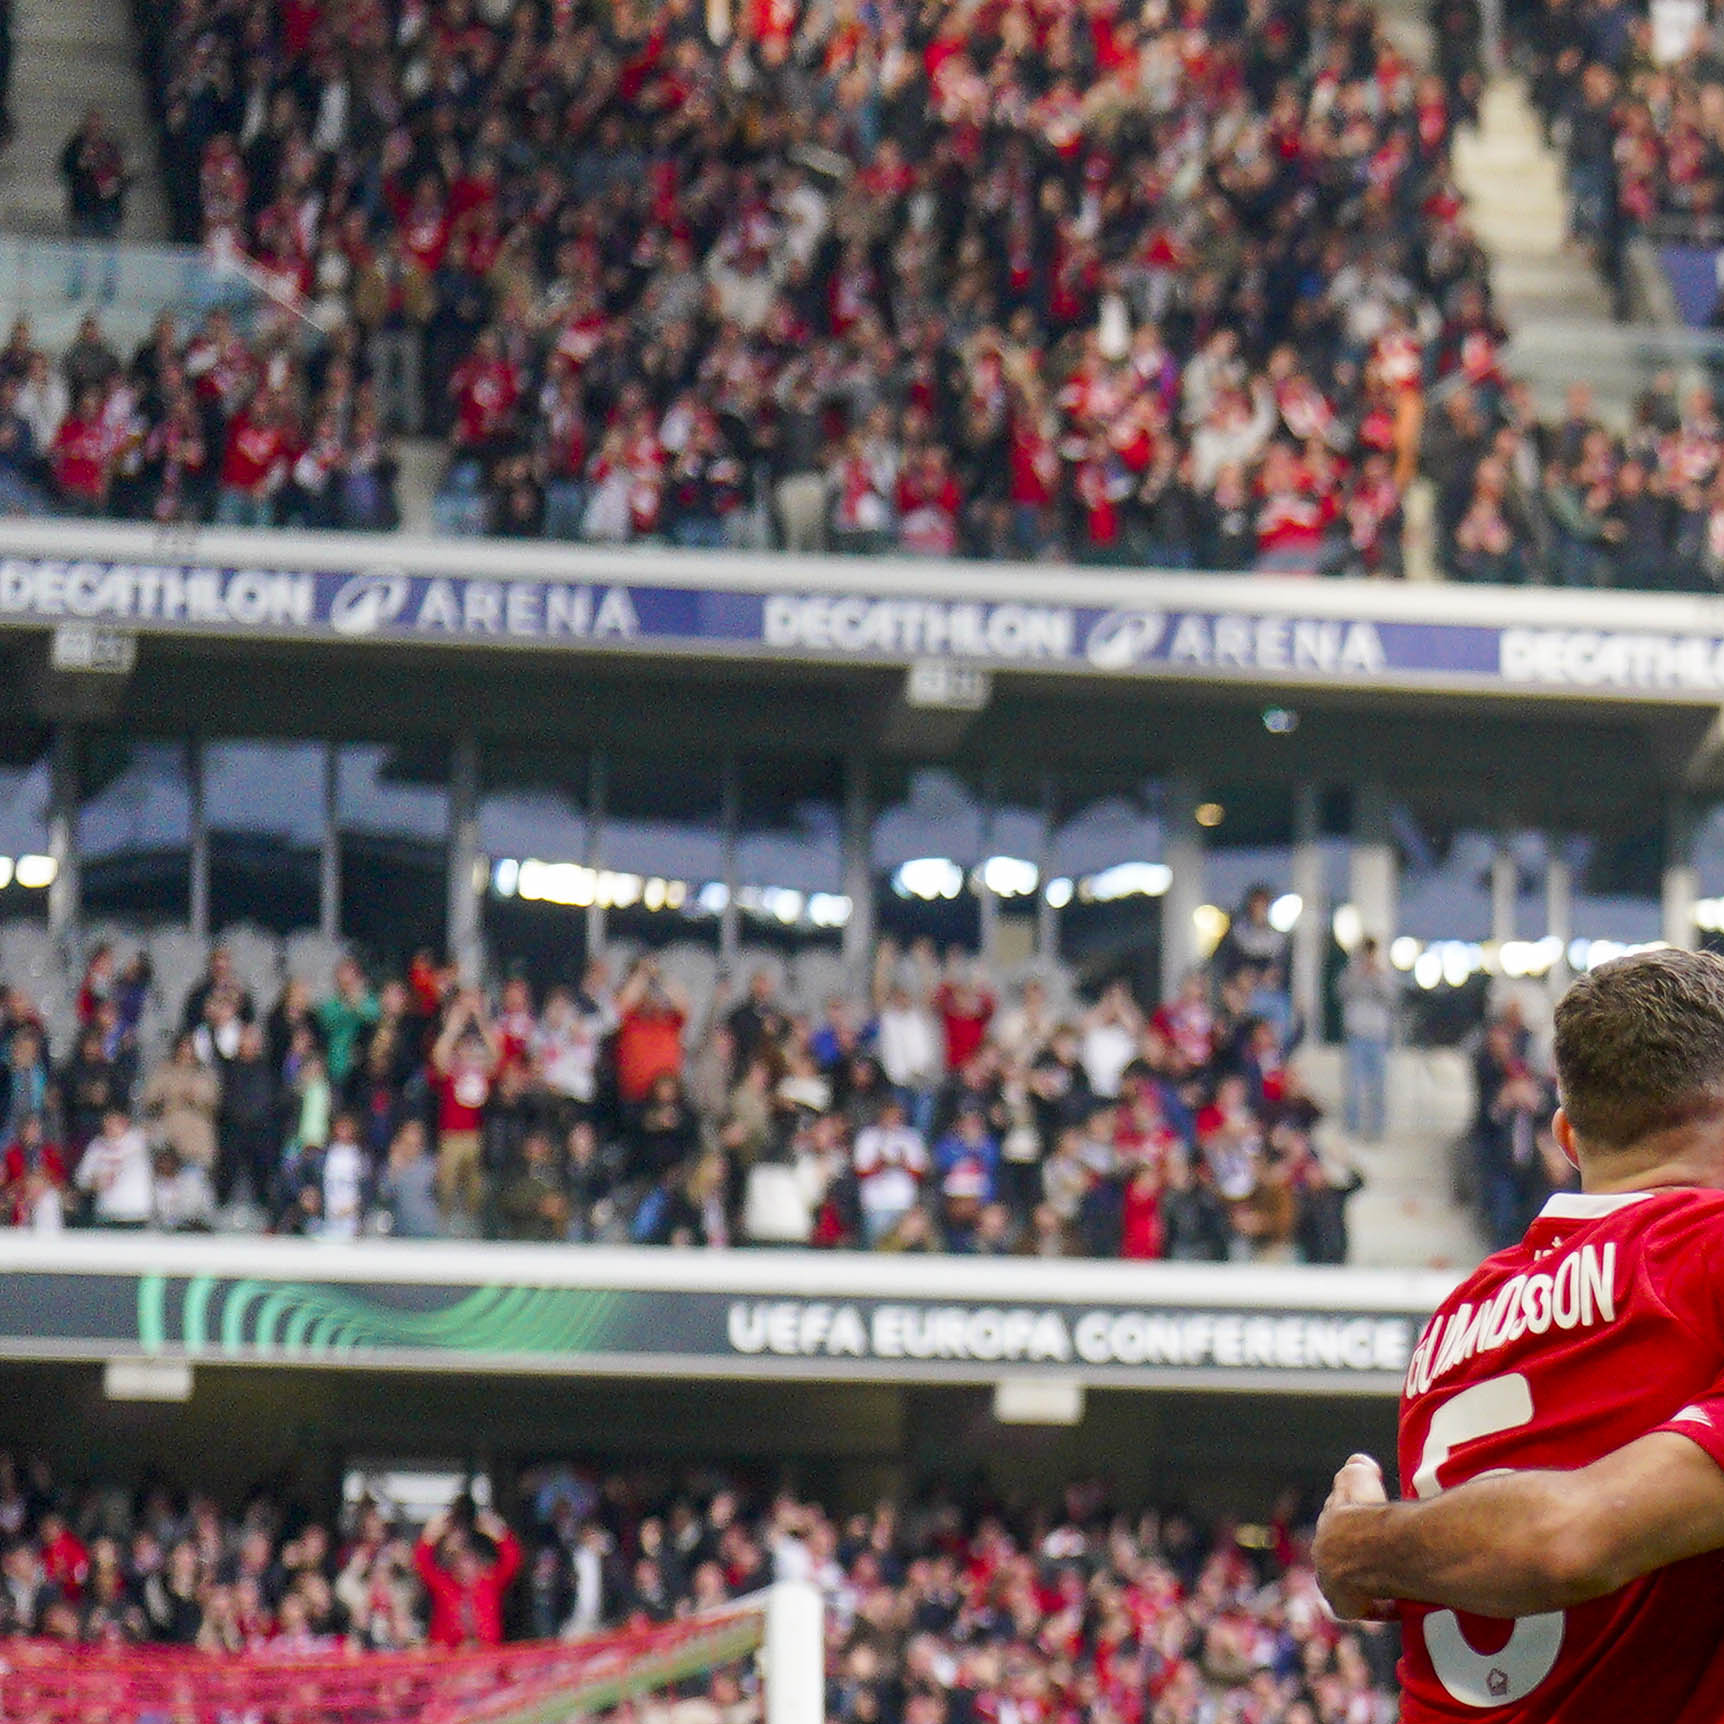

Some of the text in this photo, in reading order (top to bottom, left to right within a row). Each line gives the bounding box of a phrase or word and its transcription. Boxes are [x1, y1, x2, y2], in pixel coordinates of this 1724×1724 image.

[2, 559, 639, 640] DECATHLON ARENA
[764, 595, 1388, 674] DECATHLON ARENA
[728, 1304, 1407, 1370] UEFA EUROPA CONFERENCE
